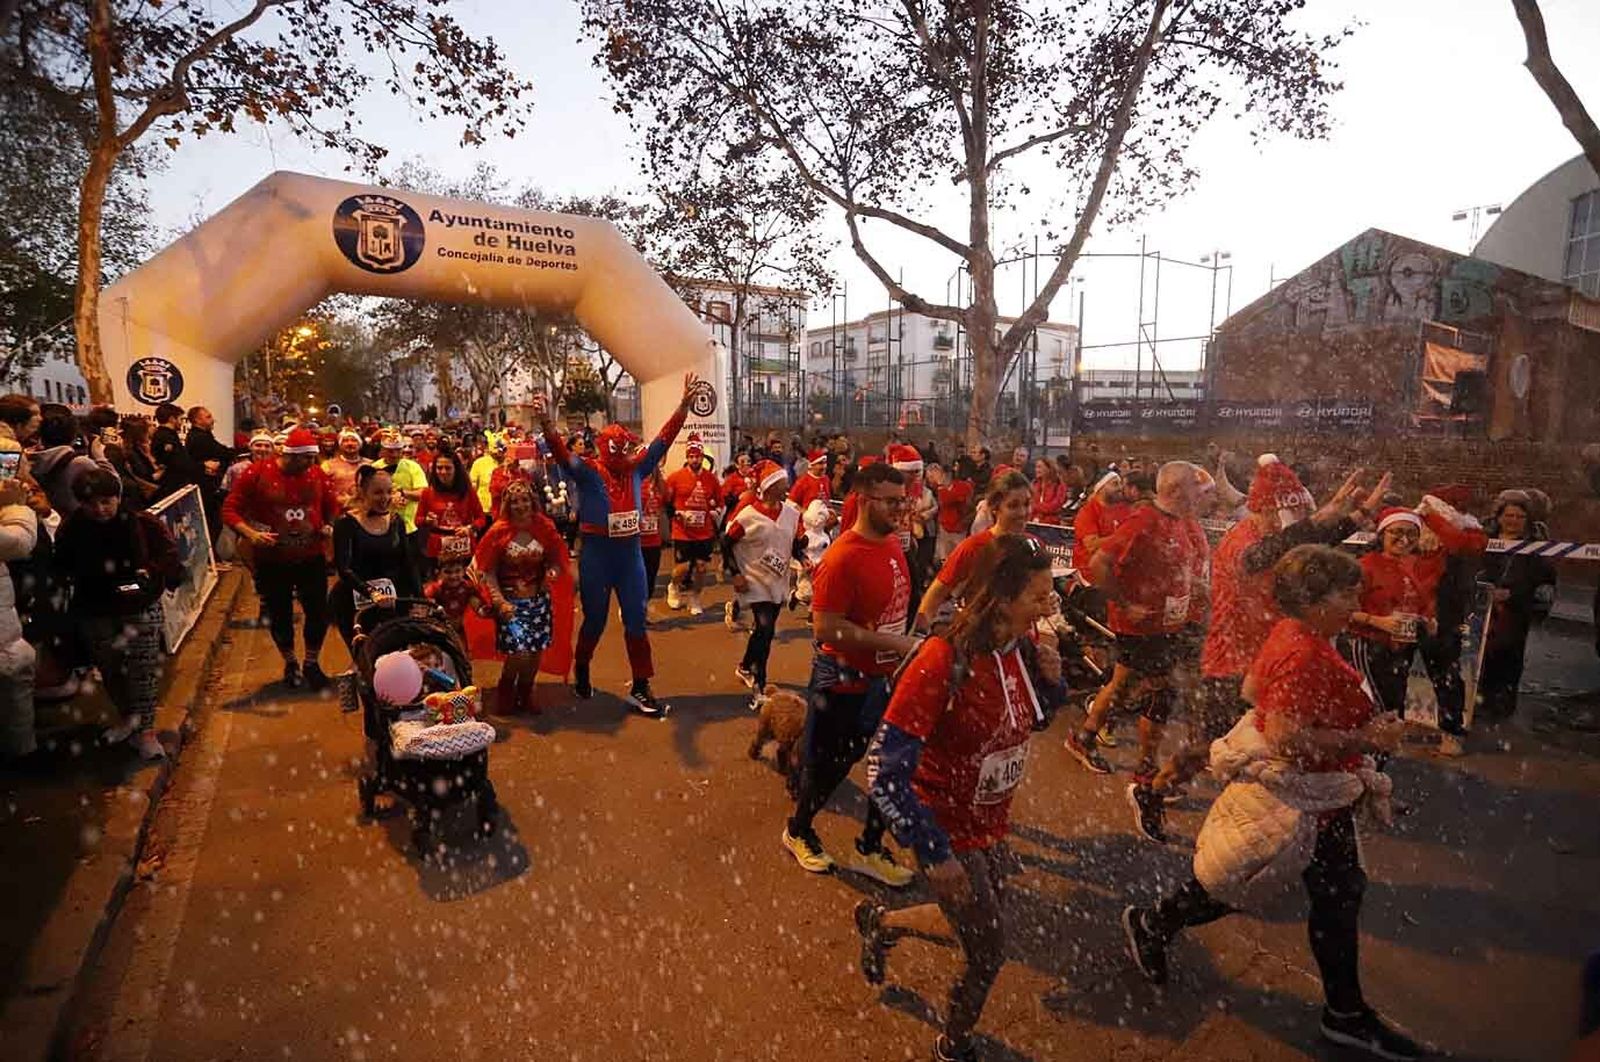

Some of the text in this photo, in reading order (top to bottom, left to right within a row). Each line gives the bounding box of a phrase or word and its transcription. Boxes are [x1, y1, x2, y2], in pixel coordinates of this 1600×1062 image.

[429, 209, 574, 240] Ayuntamiento
[473, 232, 576, 257] de Huelva
[507, 254, 522, 265] de
[526, 256, 578, 271] Deportes
